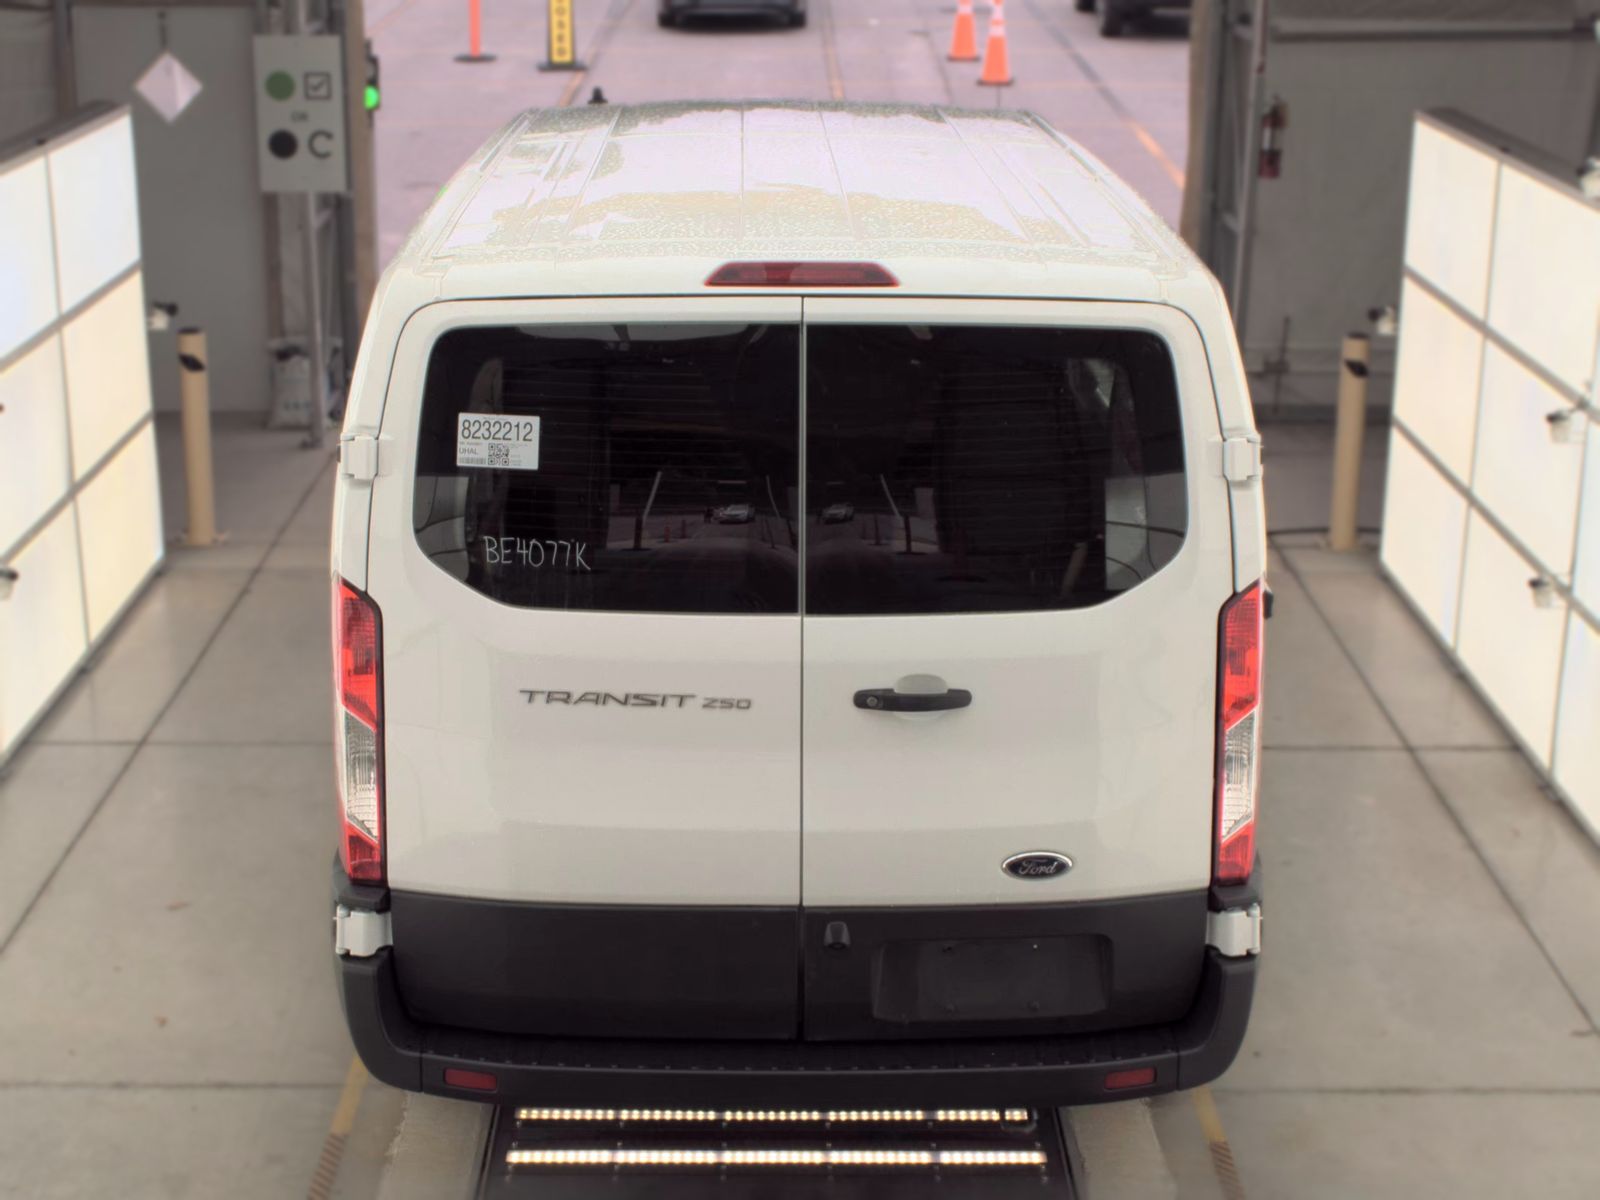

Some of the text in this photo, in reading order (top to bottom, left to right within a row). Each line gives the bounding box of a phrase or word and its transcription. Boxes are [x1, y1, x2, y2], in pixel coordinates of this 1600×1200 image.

[461, 419, 533, 441] 8232212
[483, 536, 591, 570] BE4077K
[518, 689, 752, 710] TRANSIT 250
[1018, 860, 1058, 874] Ford
